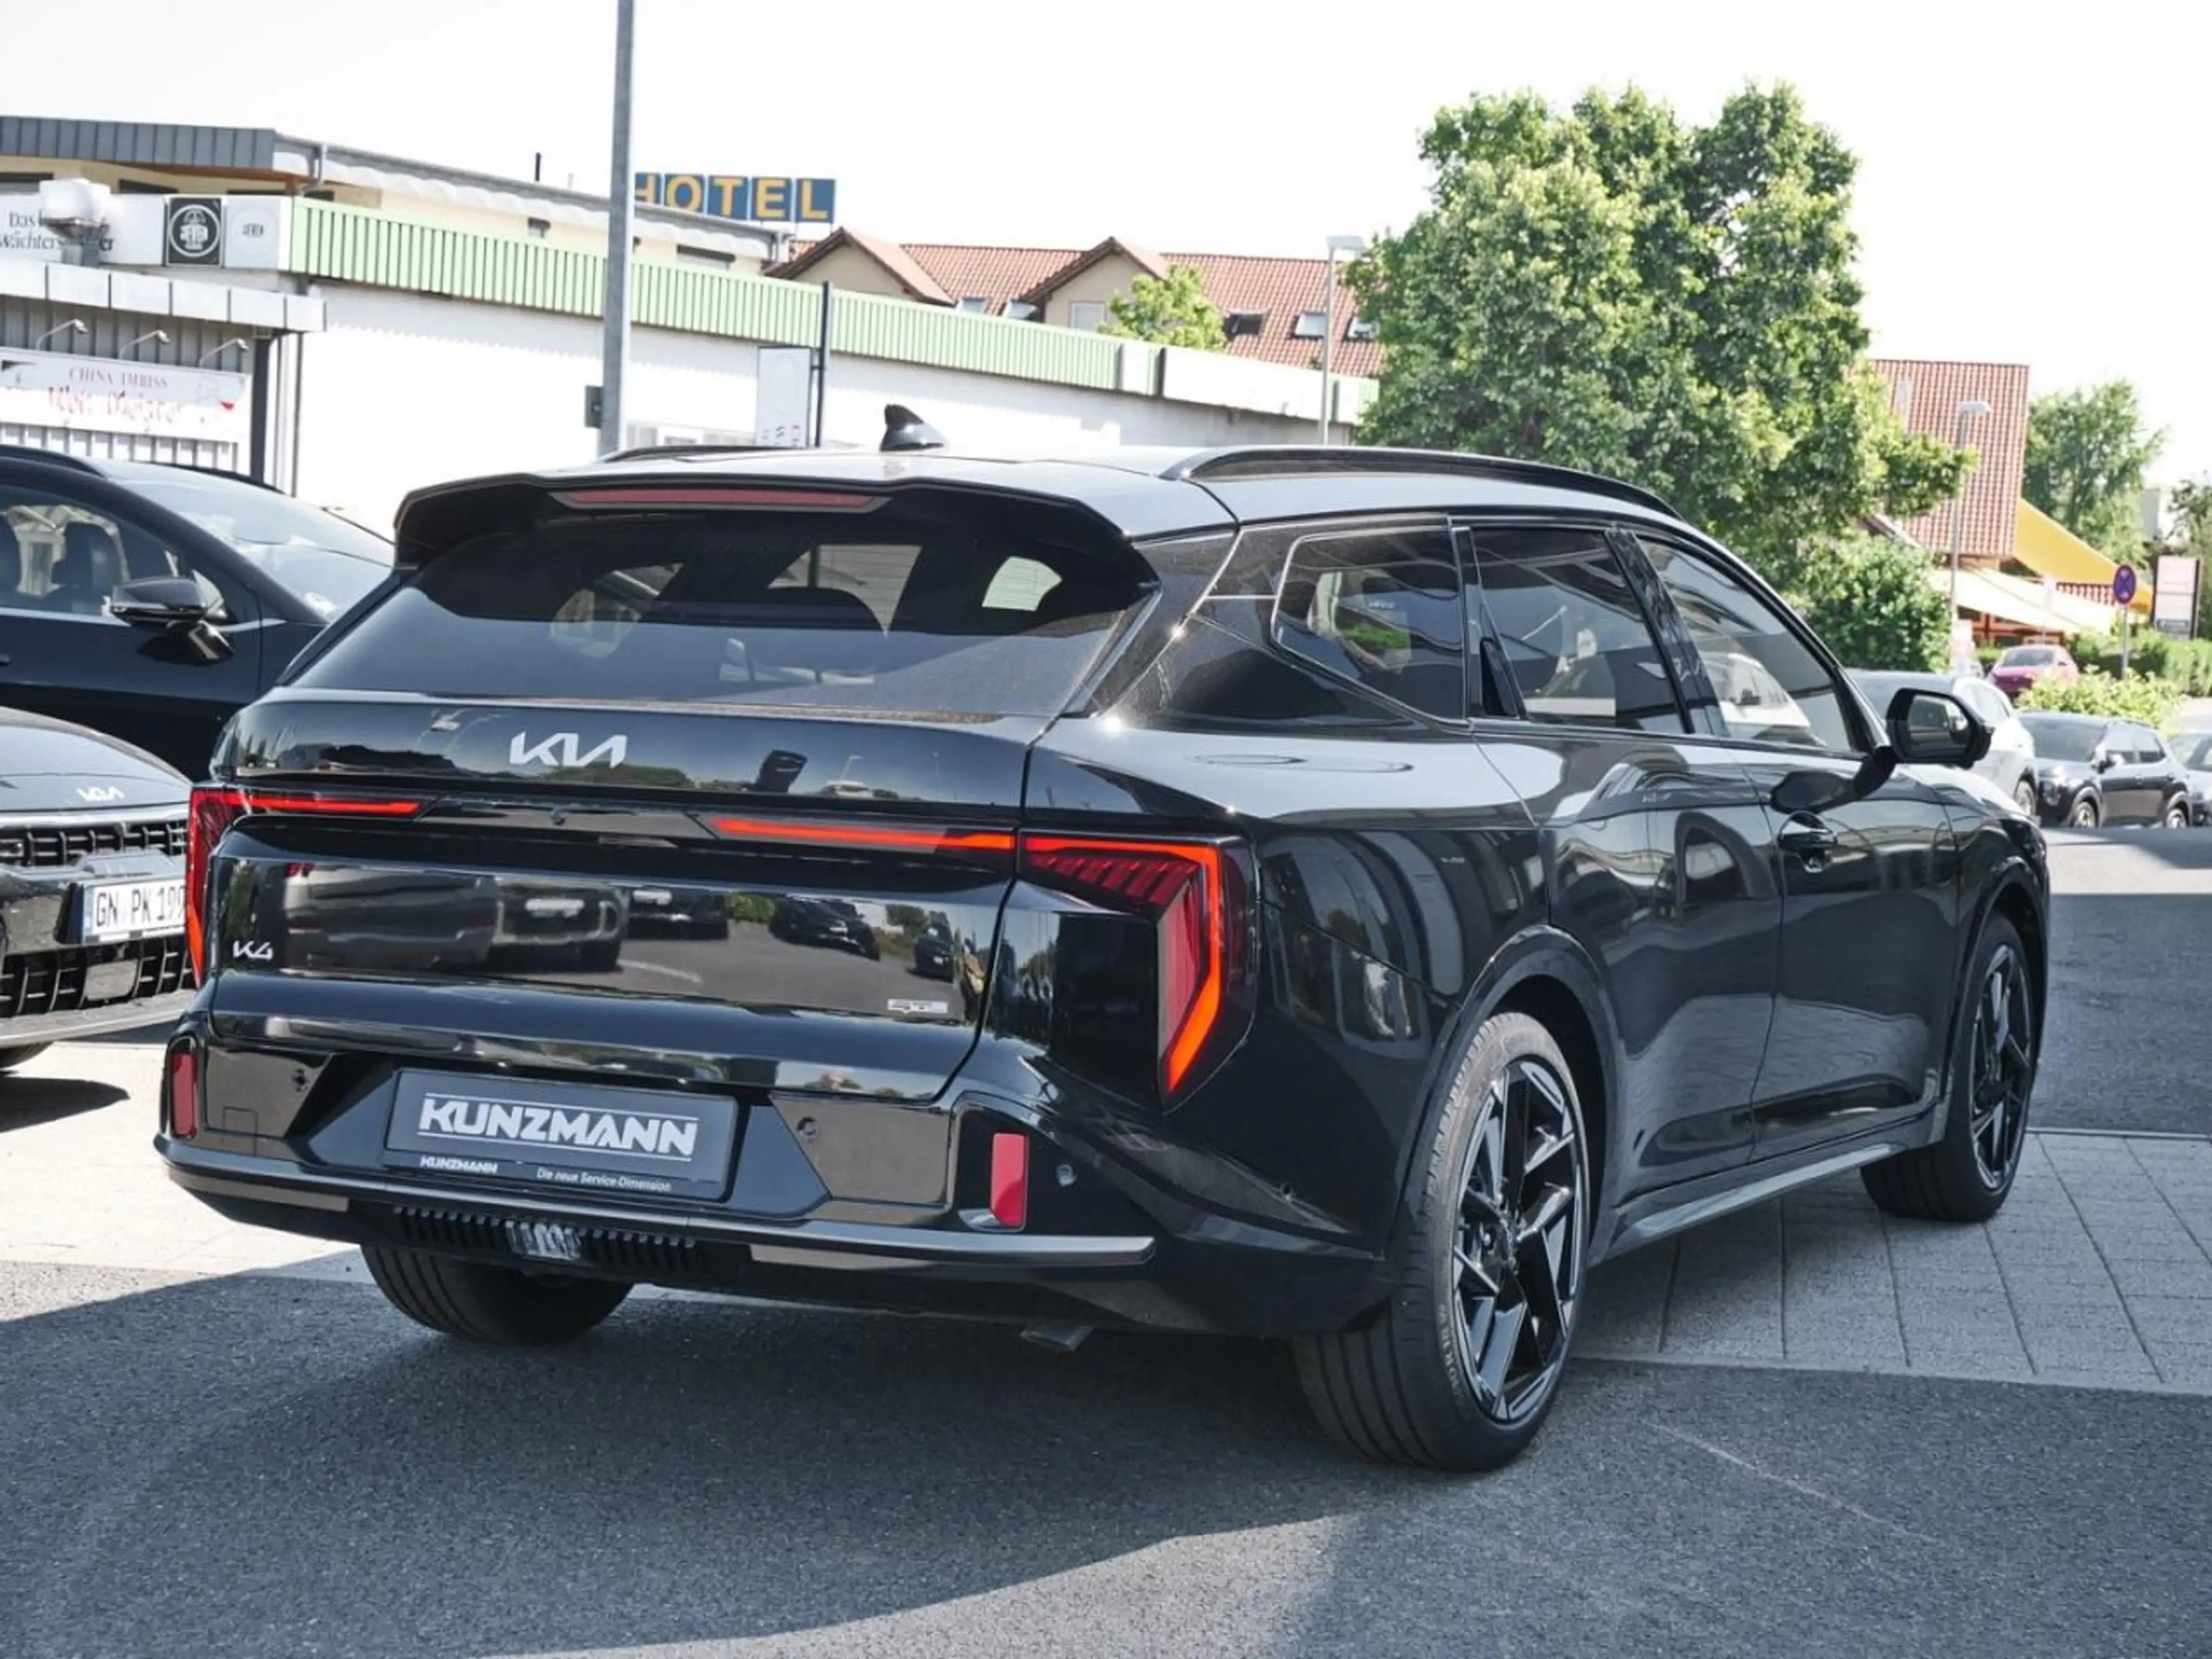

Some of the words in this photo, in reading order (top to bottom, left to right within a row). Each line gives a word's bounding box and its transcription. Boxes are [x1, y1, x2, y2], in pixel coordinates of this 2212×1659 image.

[635, 174, 828, 219] HOTEL
[10, 211, 35, 227] Das
[69, 366, 114, 384] CHINA
[122, 372, 168, 388] IMBISS
[509, 731, 628, 769] KIA
[96, 891, 118, 927] GN
[131, 889, 151, 925] PK
[233, 940, 274, 961] K4
[419, 1099, 698, 1156] KUNZMANN
[420, 1154, 499, 1174] KUNZMANN
[536, 1166, 553, 1180] Die
[555, 1171, 578, 1183] neue
